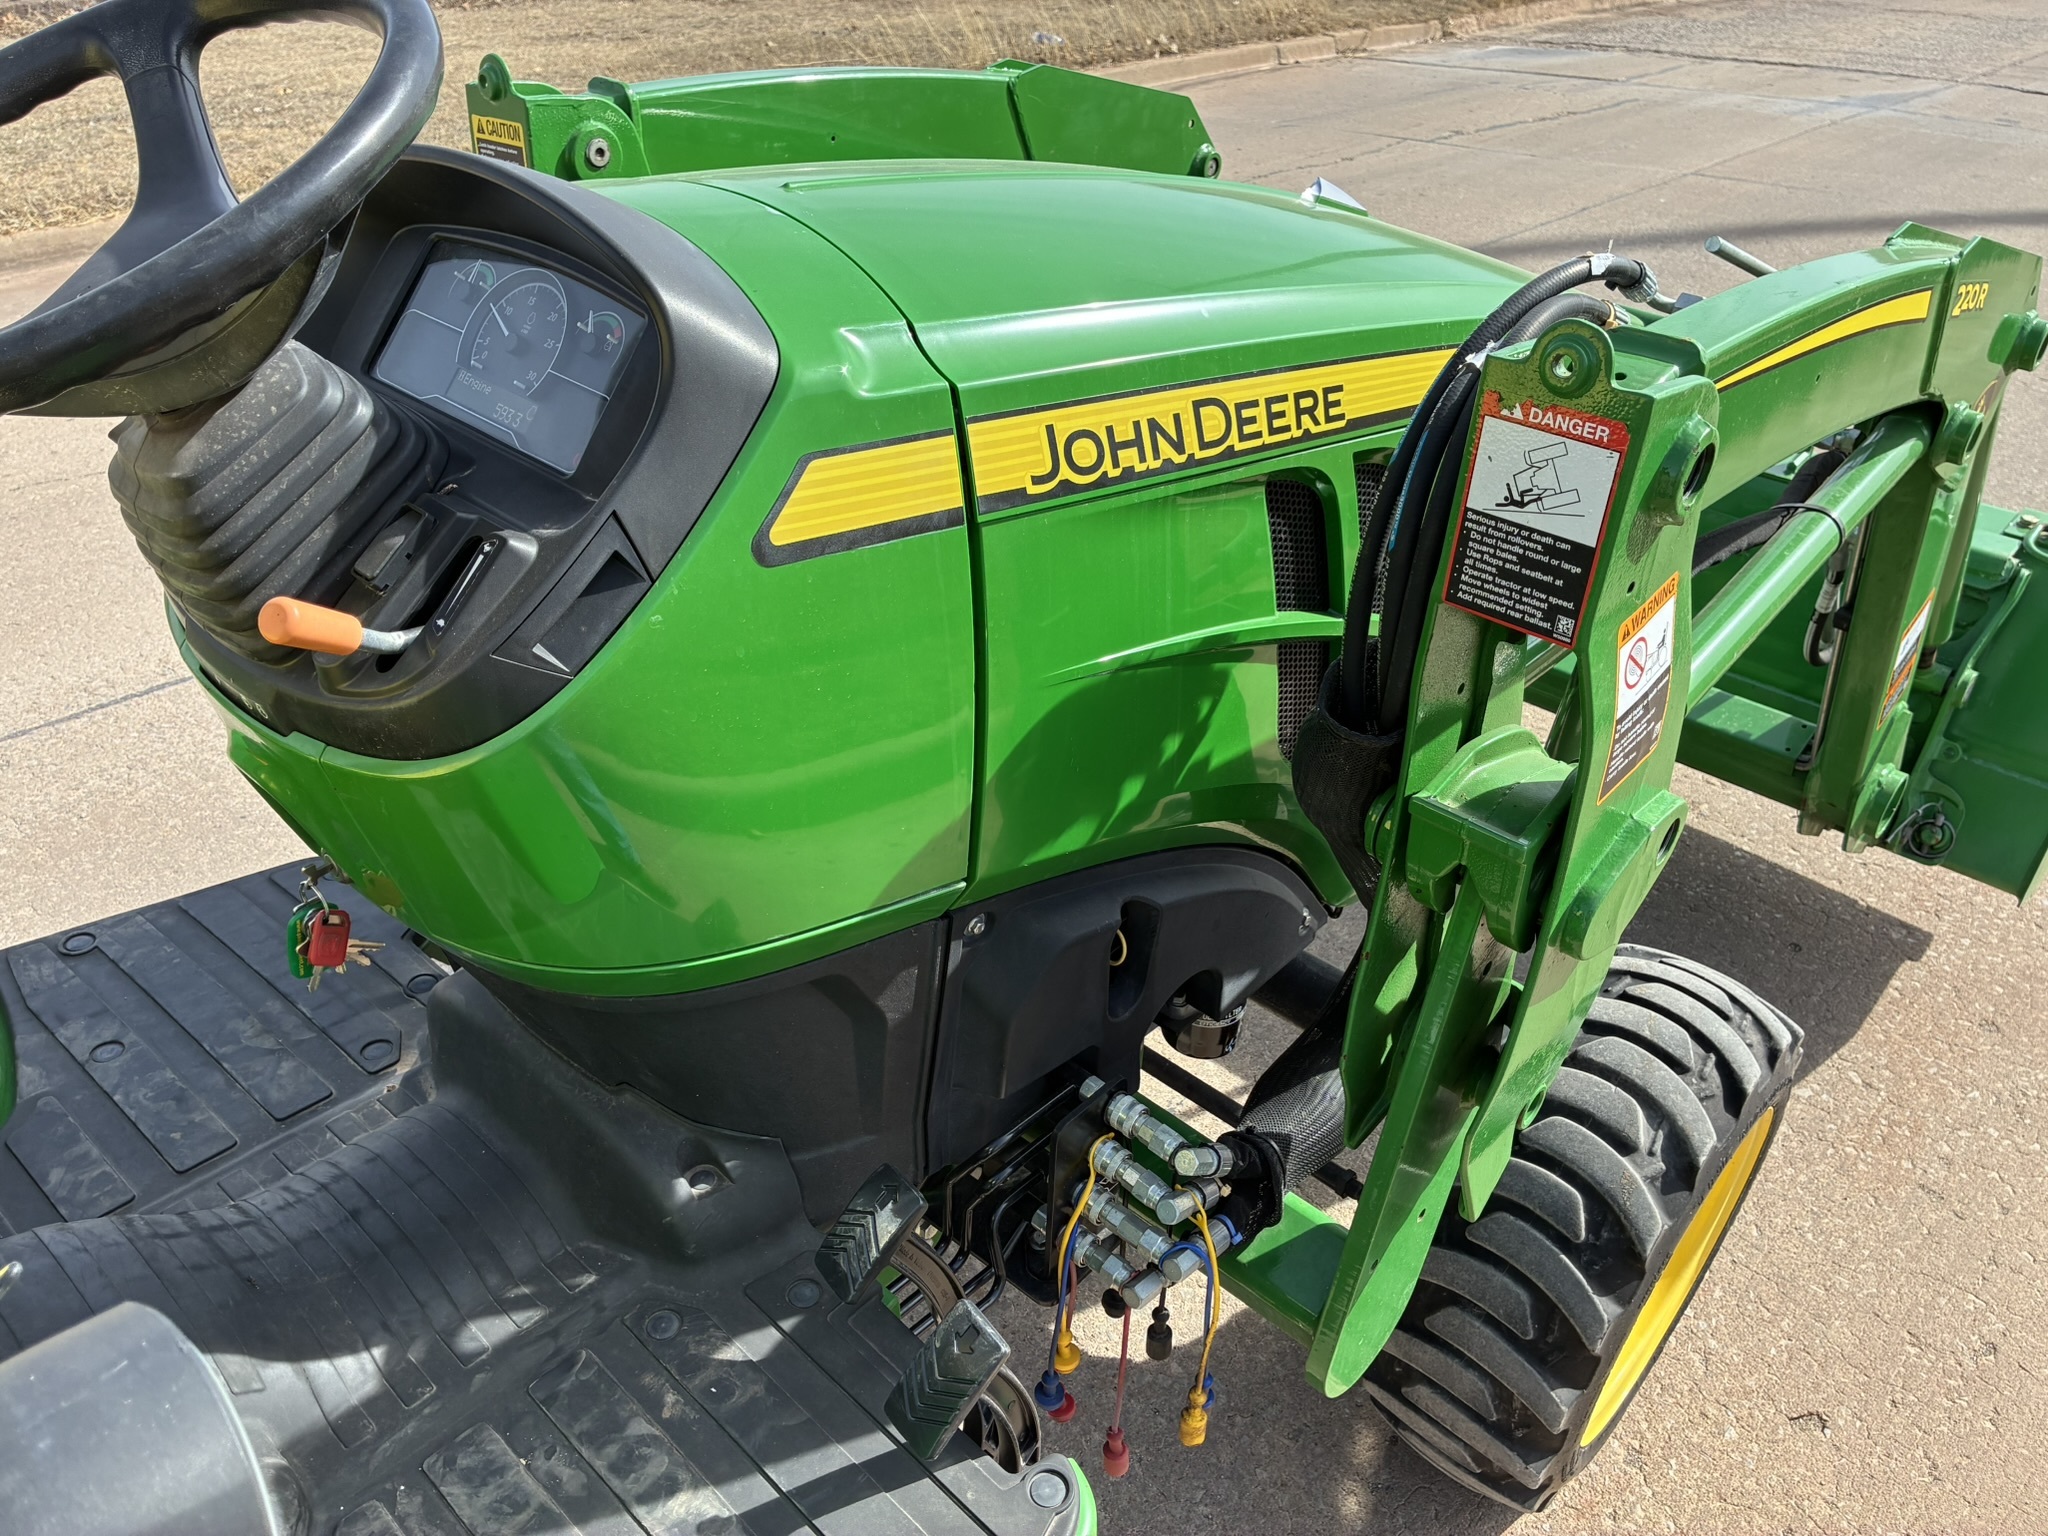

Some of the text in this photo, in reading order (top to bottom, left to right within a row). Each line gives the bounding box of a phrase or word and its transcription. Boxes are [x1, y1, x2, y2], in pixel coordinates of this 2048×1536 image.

[486, 119, 521, 142] CAUTION
[504, 306, 514, 316] 10
[527, 296, 537, 306] 15
[1952, 283, 1989, 316] 220R
[547, 311, 558, 322] 20
[481, 351, 488, 359] 0
[483, 337, 491, 345] 5
[543, 338, 555, 349] 25
[525, 370, 537, 381] 30
[1029, 411, 1186, 487] JOHN
[1191, 384, 1346, 452] DEERE
[1529, 407, 1610, 443] DANGER
[1464, 521, 1544, 551] result from rollovers.
[1467, 511, 1495, 526] Serious
[1497, 522, 1519, 534] injury
[1531, 533, 1554, 545] death
[1556, 541, 1571, 551] can
[1468, 541, 1518, 562] square bales.
[1470, 531, 1481, 540] Do
[1483, 536, 1496, 546] not
[1497, 541, 1524, 554] handle
[1525, 550, 1549, 562] round
[1561, 561, 1582, 574] large
[1467, 549, 1481, 559] Use
[1505, 562, 1520, 572] and
[1521, 568, 1554, 583] seatbelt
[1555, 579, 1563, 587] at
[1475, 562, 1498, 574] times.
[1459, 584, 1544, 617] recommended setting.
[1461, 574, 1481, 586] Move
[1484, 583, 1510, 596] wheels
[1522, 596, 1548, 610] widest
[1463, 566, 1575, 610] Operate tractor at low speed.
[1632, 577, 1676, 627] WARNING
[1457, 591, 1552, 630] Add required rear ballast.
